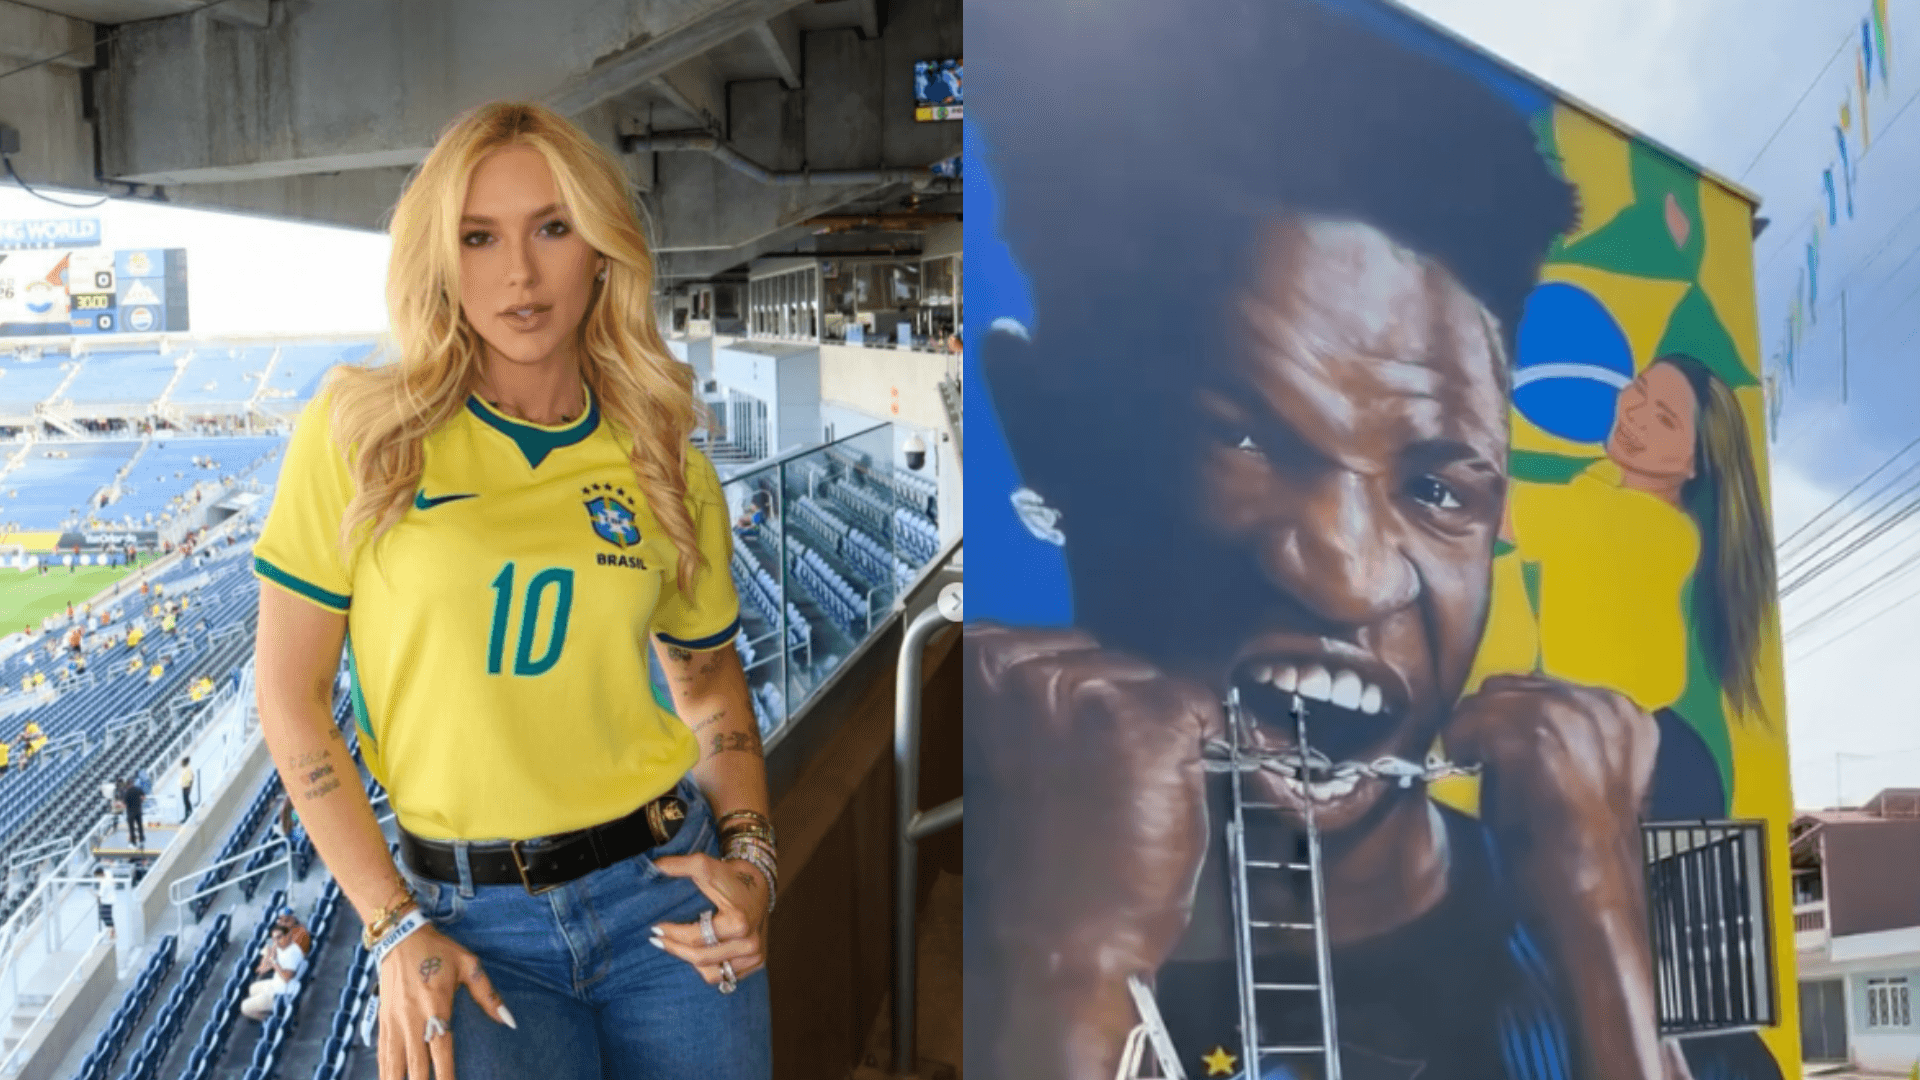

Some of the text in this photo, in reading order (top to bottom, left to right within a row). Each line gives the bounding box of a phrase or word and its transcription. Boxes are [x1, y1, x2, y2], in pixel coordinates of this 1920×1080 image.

[26, 219, 97, 240] WORLD
[98, 274, 109, 286] 0
[99, 316, 111, 328] 0
[596, 552, 648, 571] BRASIL
[487, 561, 575, 678] 10
[382, 919, 415, 948] SUITES
